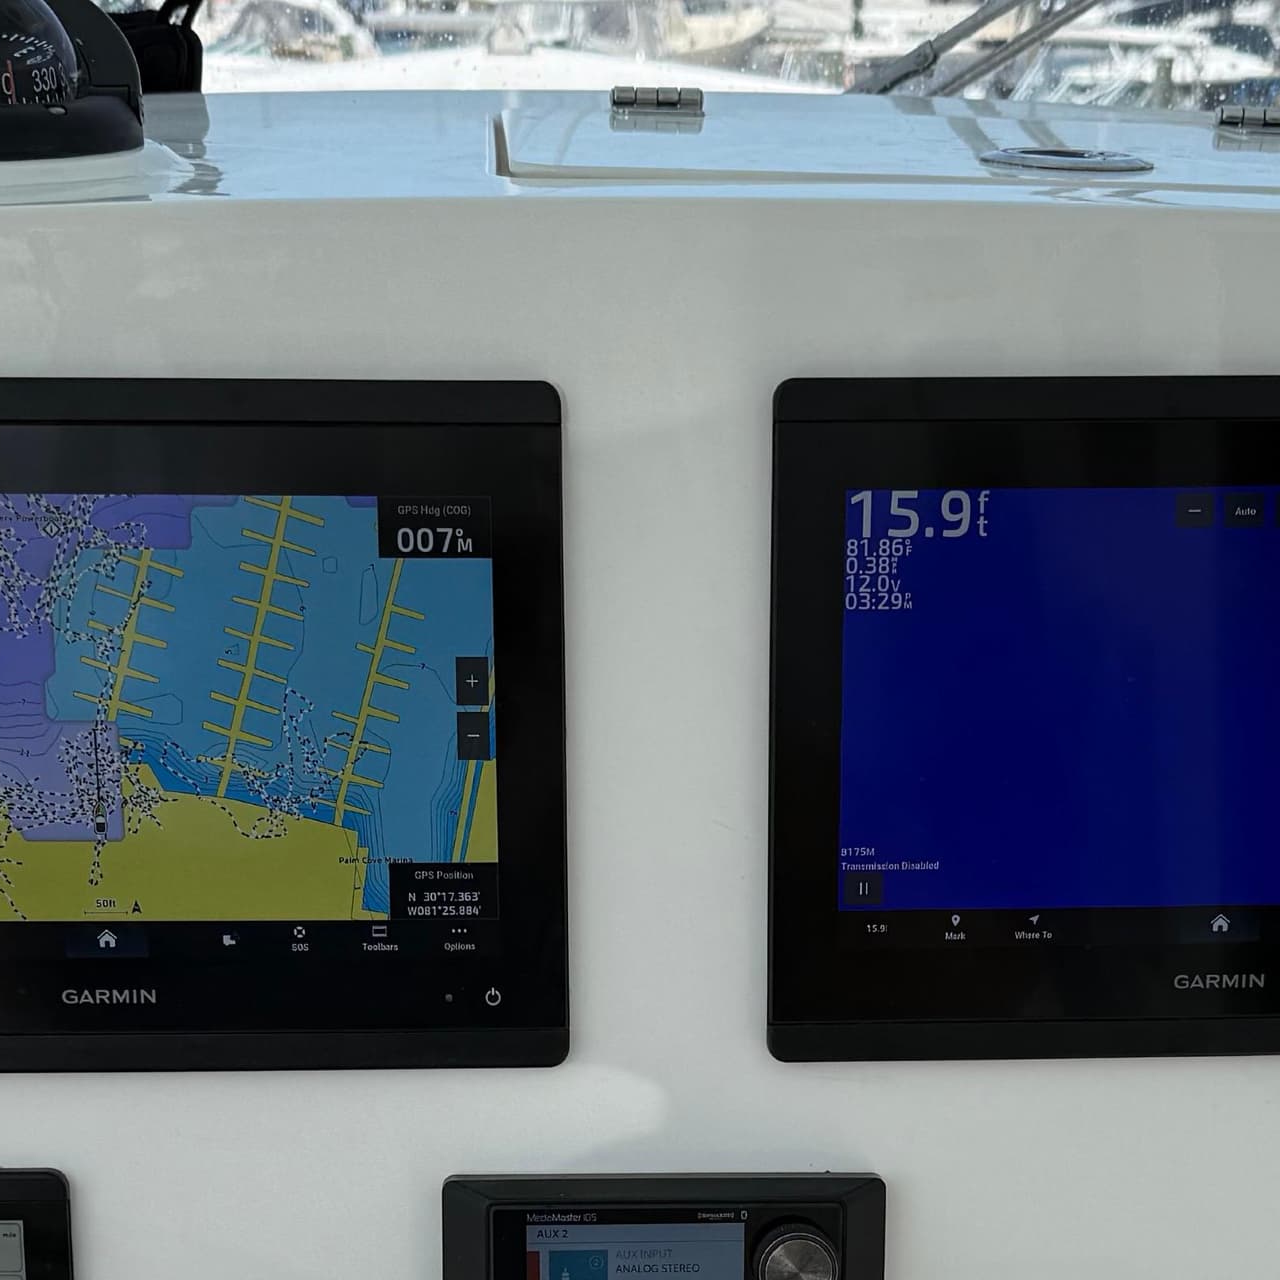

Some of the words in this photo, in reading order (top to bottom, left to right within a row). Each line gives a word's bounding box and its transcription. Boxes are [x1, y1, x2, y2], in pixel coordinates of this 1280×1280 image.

[398, 505, 418, 516] GPS
[420, 505, 440, 518] Hdg
[443, 505, 471, 517] (COG)
[1235, 507, 1256, 516] Auto
[363, 942, 398, 951] Toolbars
[444, 942, 475, 953] Options
[1174, 974, 1265, 989] GARMIN
[62, 988, 157, 1004] GARMIN
[537, 1230, 559, 1238] AUX
[561, 1229, 568, 1238] 2
[616, 1264, 659, 1273] ANALOG
[662, 1263, 700, 1273] STEREO
